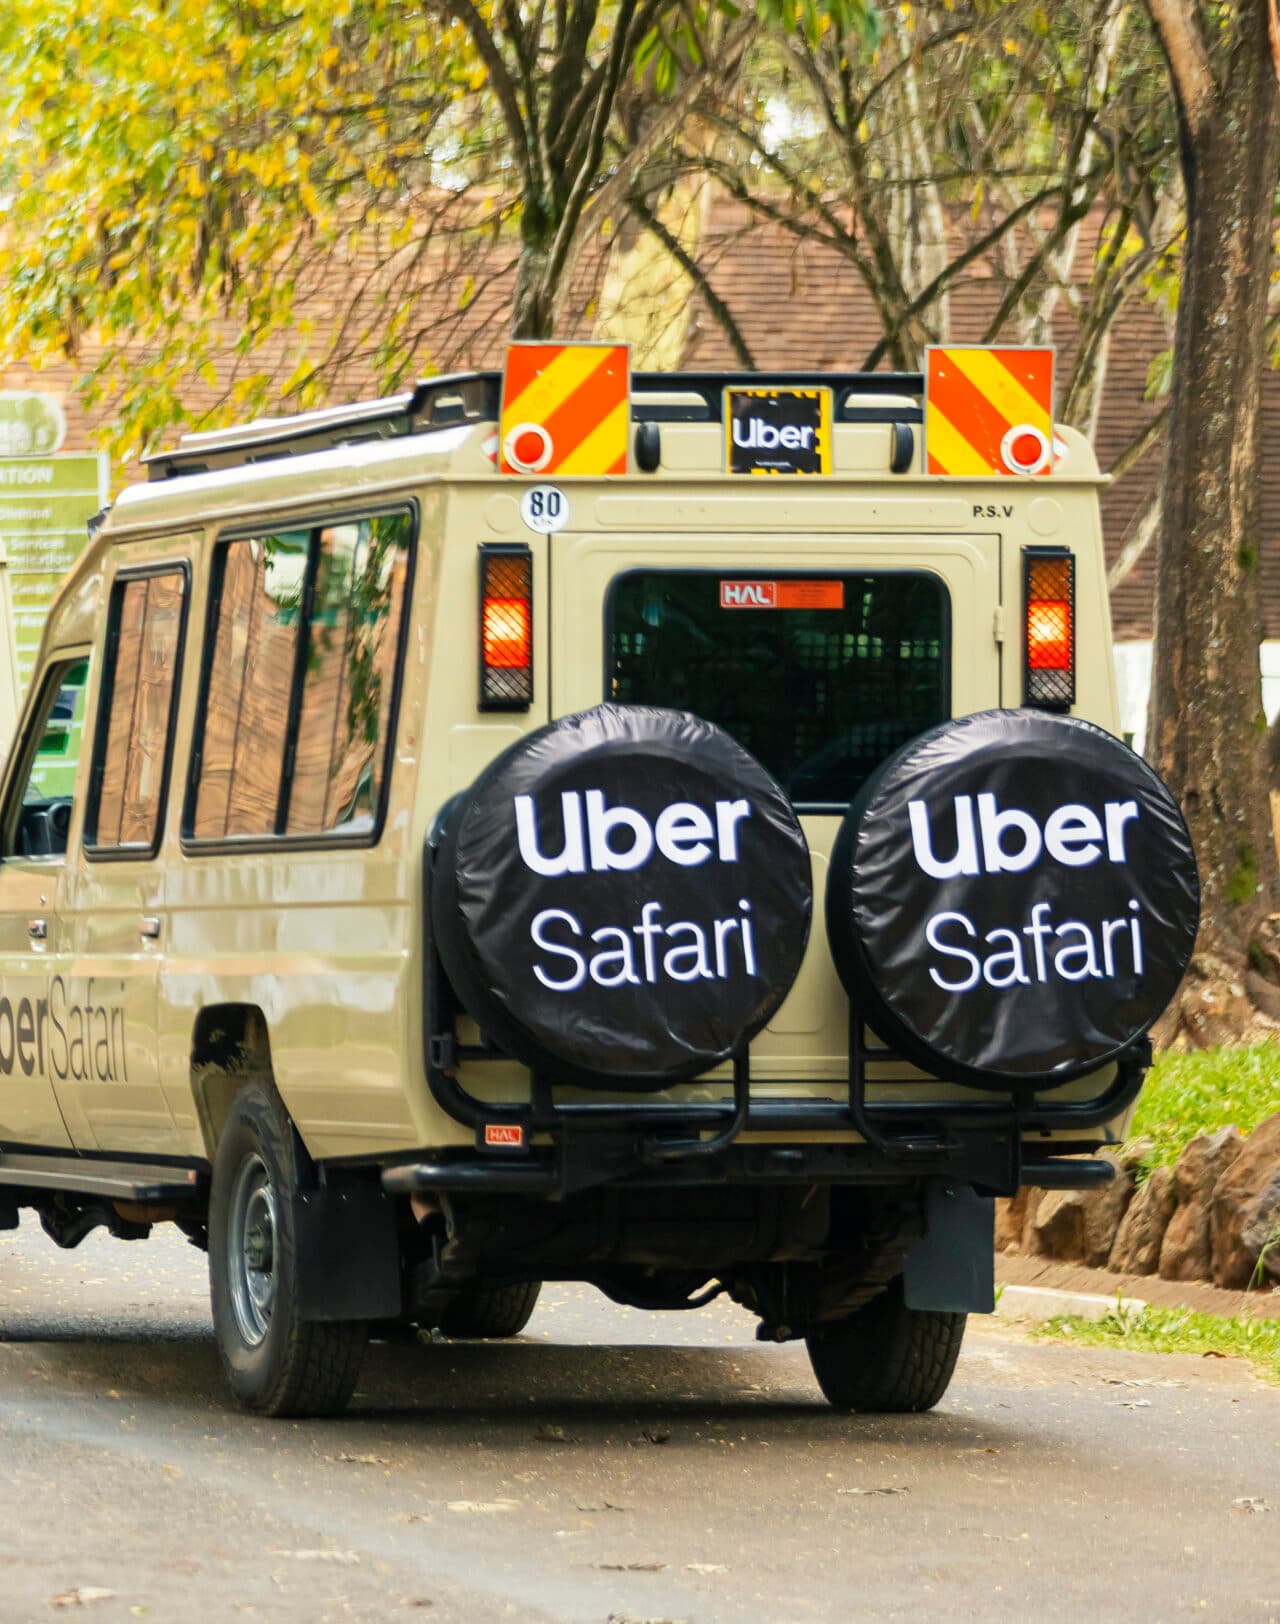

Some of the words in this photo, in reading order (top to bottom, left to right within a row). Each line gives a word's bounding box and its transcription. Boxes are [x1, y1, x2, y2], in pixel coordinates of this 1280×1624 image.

[732, 417, 814, 450] Uber
[531, 491, 560, 517] 80
[724, 585, 771, 604] HAL
[514, 790, 750, 878] Uber
[907, 792, 1138, 880] Uber
[530, 898, 757, 992] Safari
[926, 899, 1143, 992] Safari
